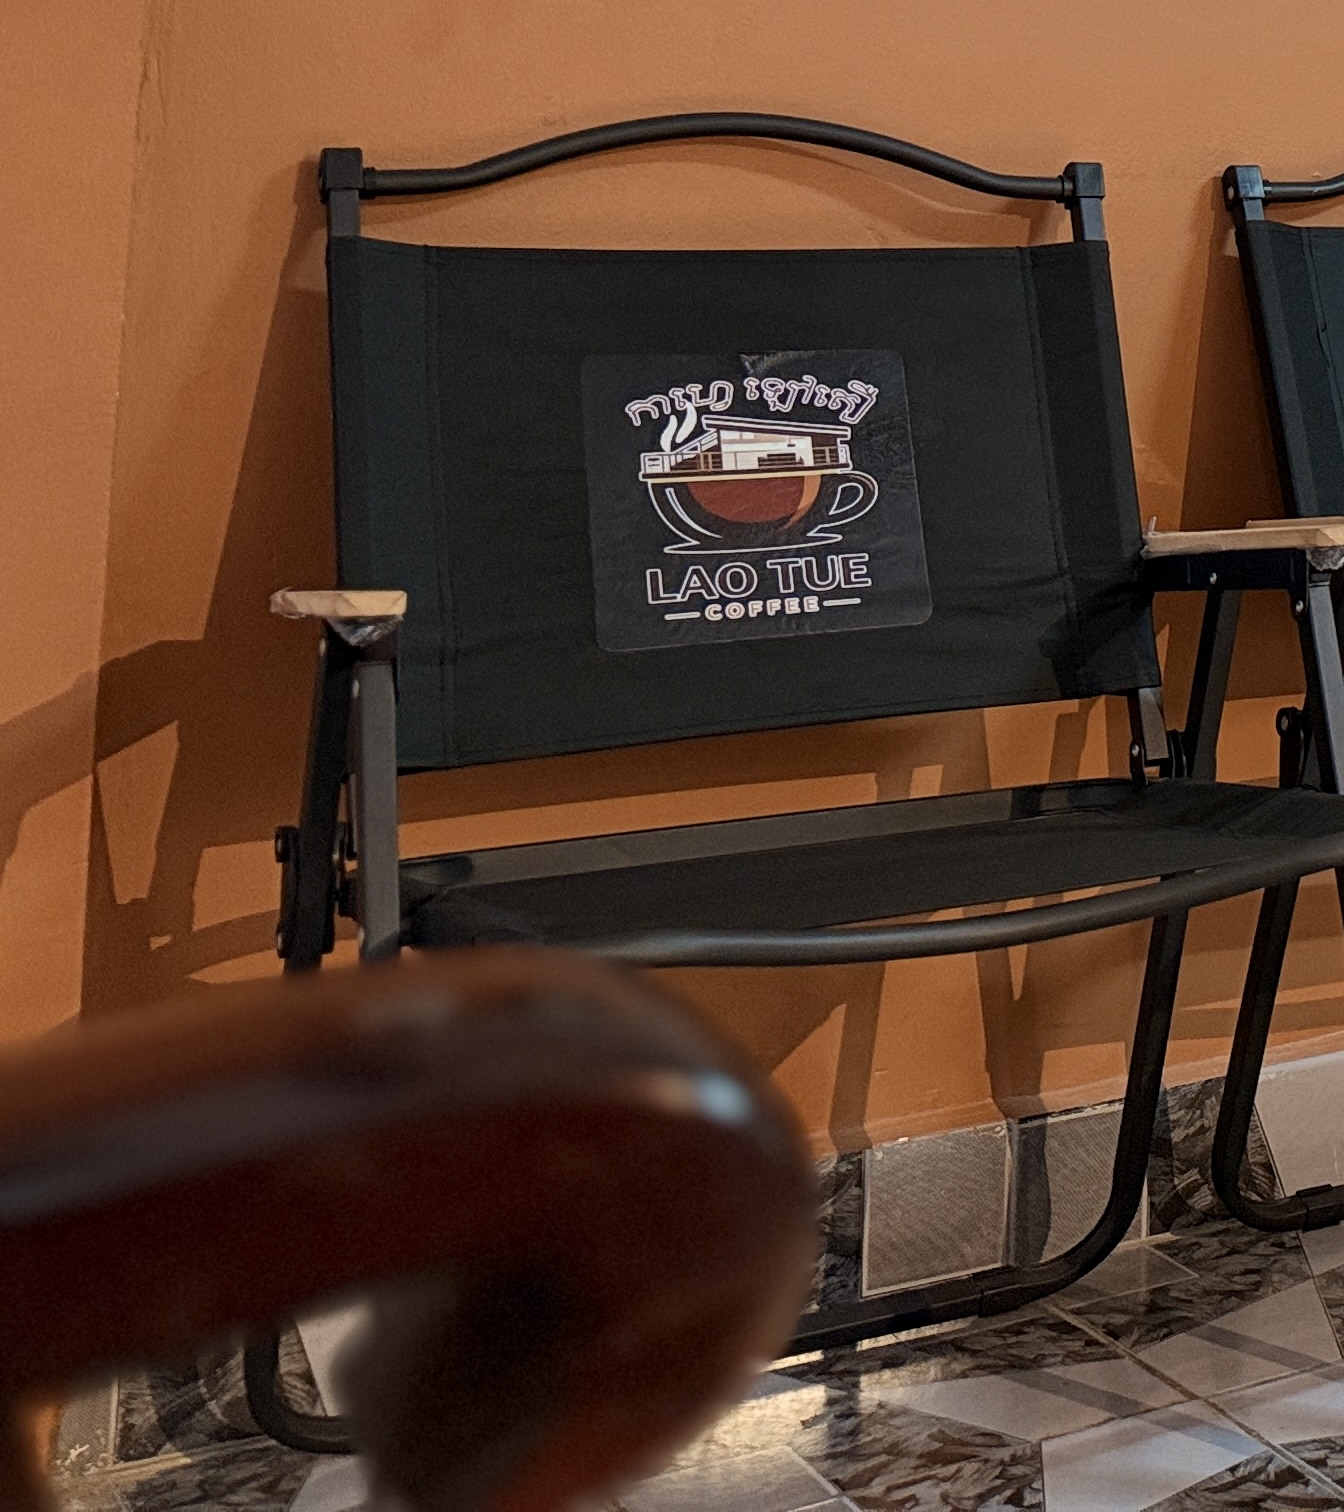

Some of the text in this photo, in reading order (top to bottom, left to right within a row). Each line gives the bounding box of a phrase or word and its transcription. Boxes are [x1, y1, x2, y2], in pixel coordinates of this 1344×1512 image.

[646, 553, 872, 605] LAO TUE
[705, 596, 820, 621] COFFEE
